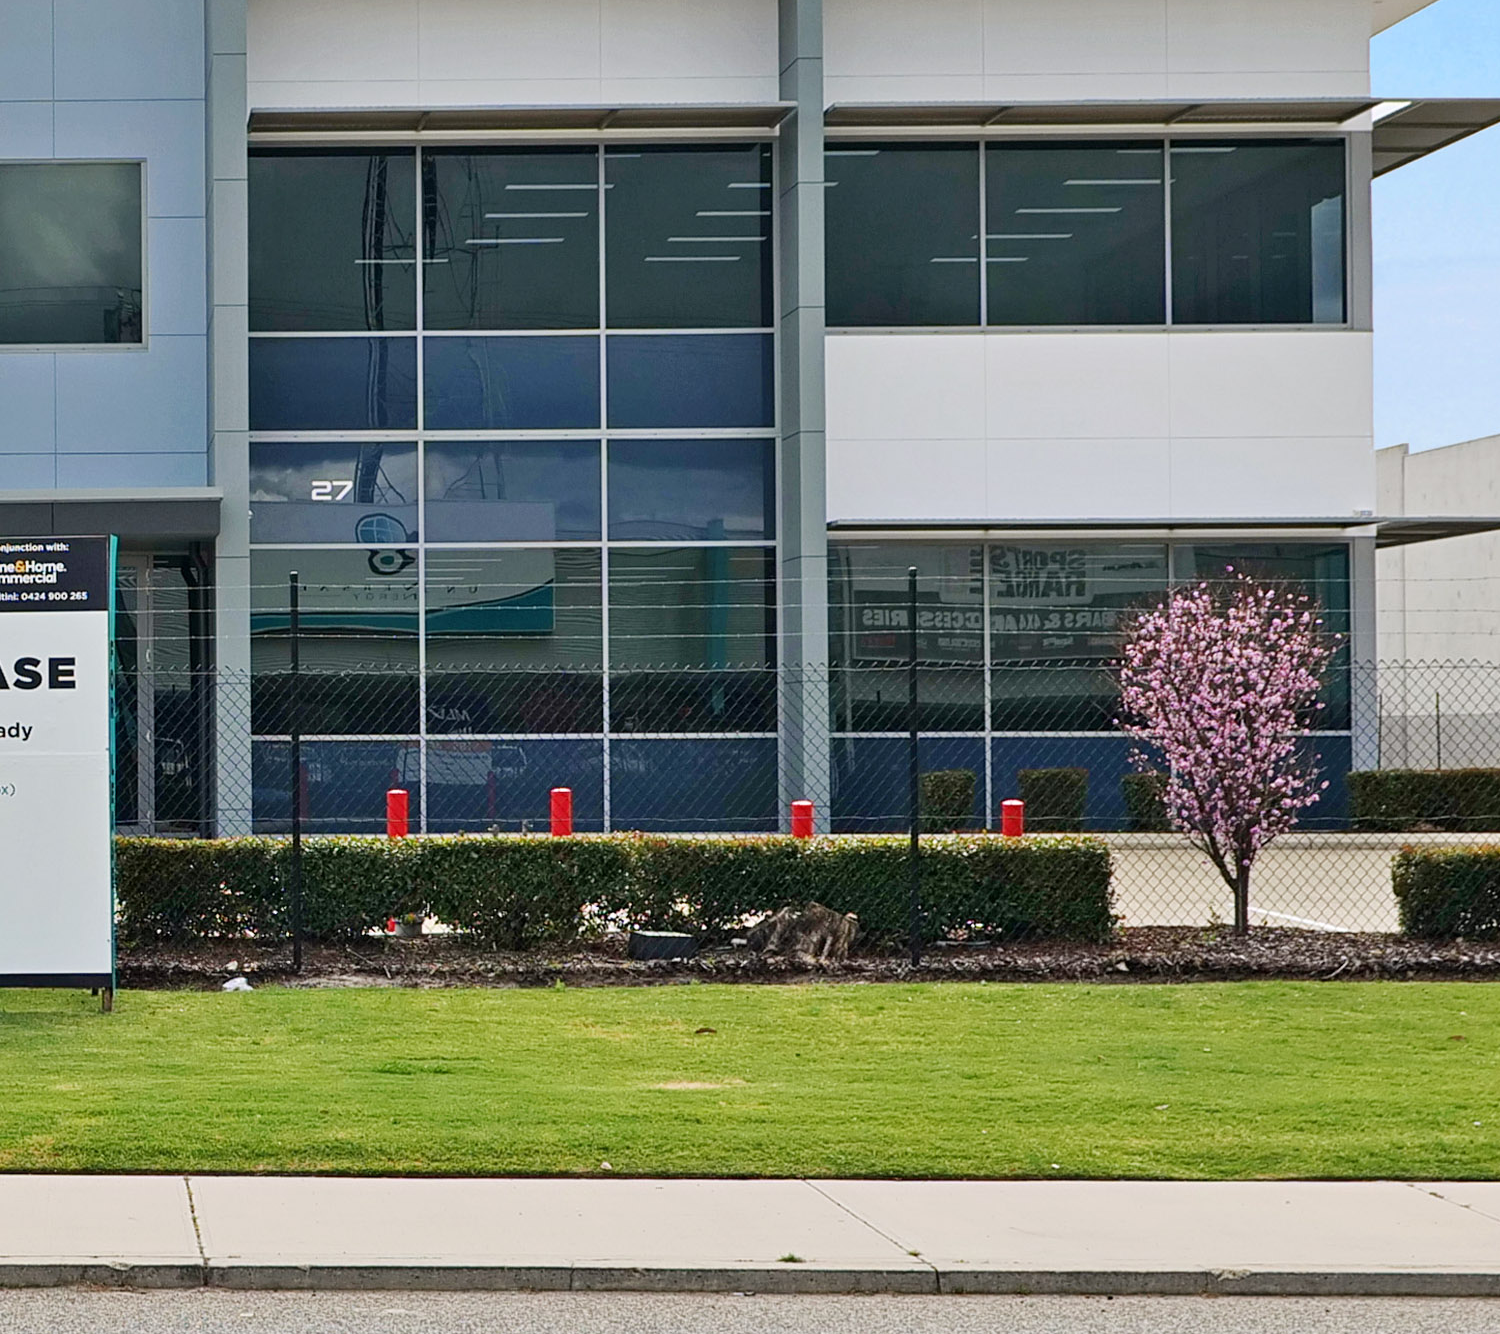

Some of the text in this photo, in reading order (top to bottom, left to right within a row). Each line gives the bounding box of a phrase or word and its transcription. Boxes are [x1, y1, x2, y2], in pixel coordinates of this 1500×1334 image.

[311, 480, 354, 501] 27
[45, 542, 70, 552] with:
[21, 591, 45, 601] 0424
[48, 591, 68, 600] 900
[69, 591, 88, 600] 265
